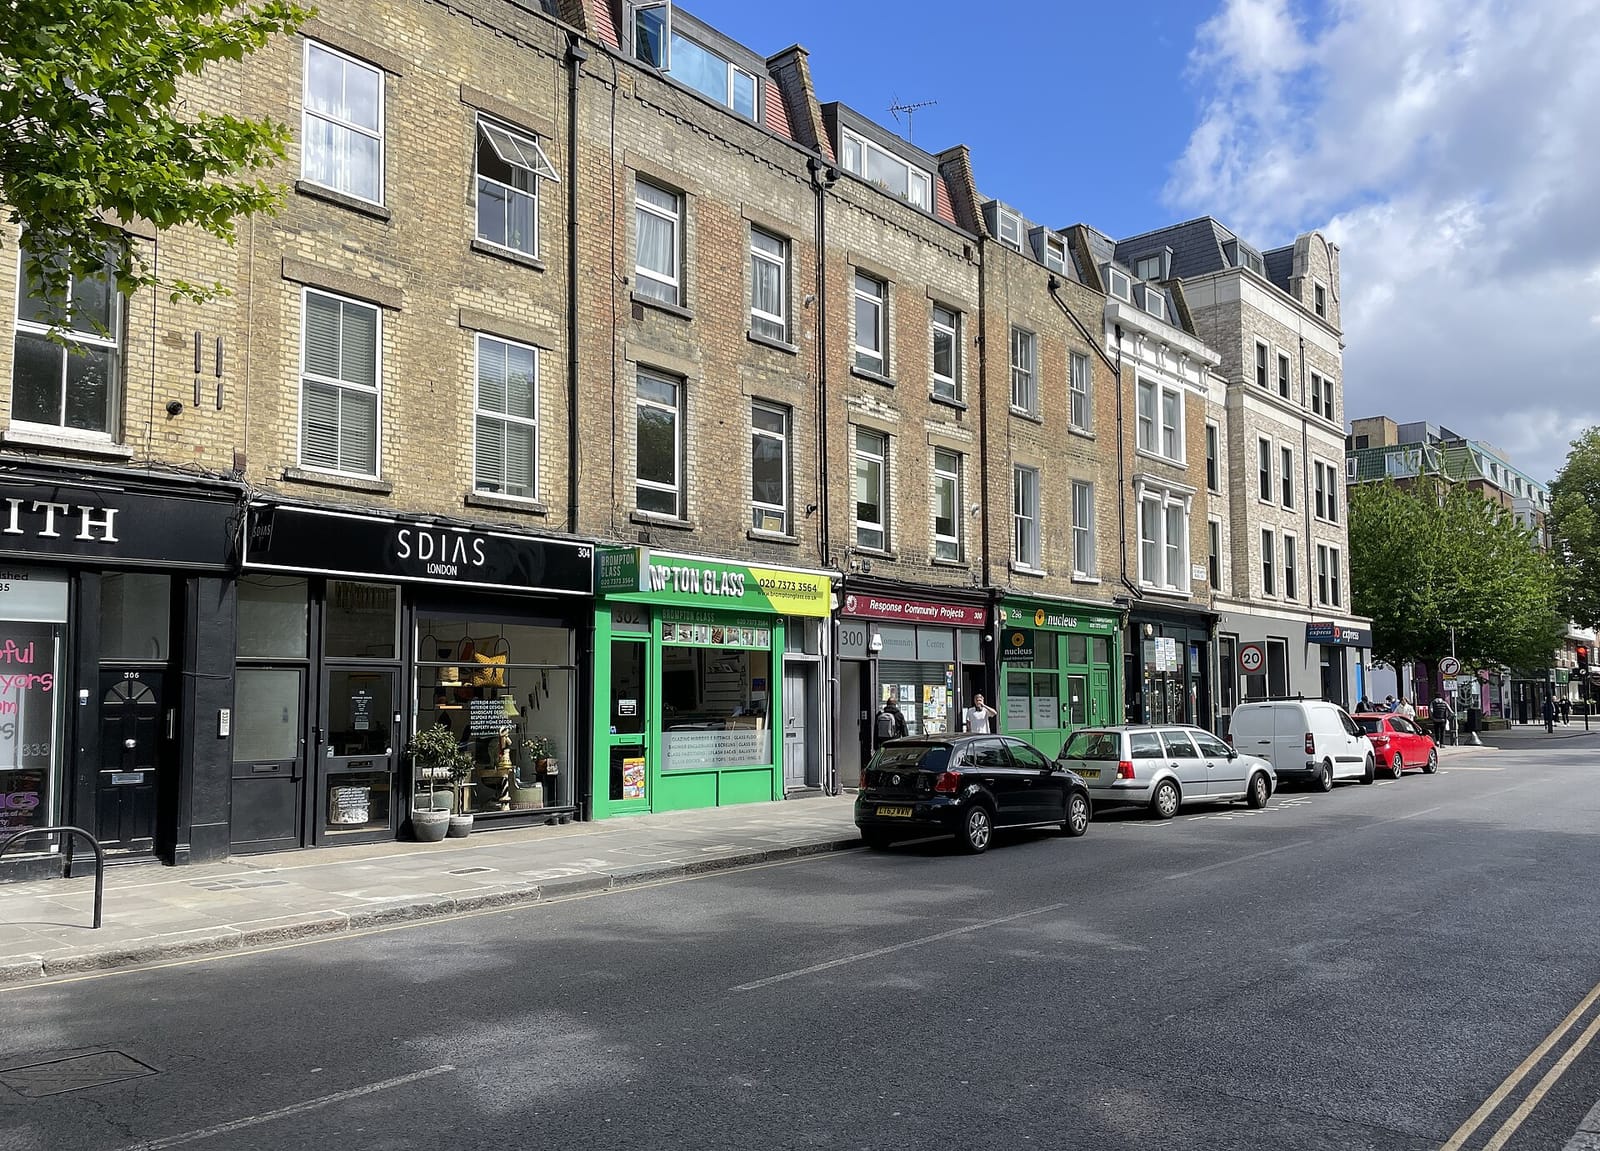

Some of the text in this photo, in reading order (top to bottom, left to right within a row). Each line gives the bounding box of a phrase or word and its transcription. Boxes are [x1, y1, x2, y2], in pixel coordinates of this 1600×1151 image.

[4, 498, 119, 542] ITH
[397, 529, 485, 566] SDIAS
[577, 548, 591, 559] 304
[601, 553, 634, 566] BROMPTON
[0, 571, 29, 580] shed
[427, 563, 457, 576] LONDON
[601, 565, 621, 577] GLASS
[703, 570, 745, 597] GLASS
[759, 578, 817, 593] 020 7373 3564
[616, 607, 640, 624] 302
[663, 608, 715, 622] BROMPTON GLASS
[870, 600, 902, 612] Response
[904, 604, 938, 617] Community
[940, 608, 964, 618] Projects
[1047, 614, 1077, 627] nucleus
[841, 630, 863, 646] 300
[1309, 629, 1331, 637] express
[1342, 630, 1359, 642] express
[883, 638, 944, 649] ommunity Centre
[0, 640, 34, 663] ful
[1004, 647, 1033, 655] nucleus
[1244, 653, 1260, 664] 20
